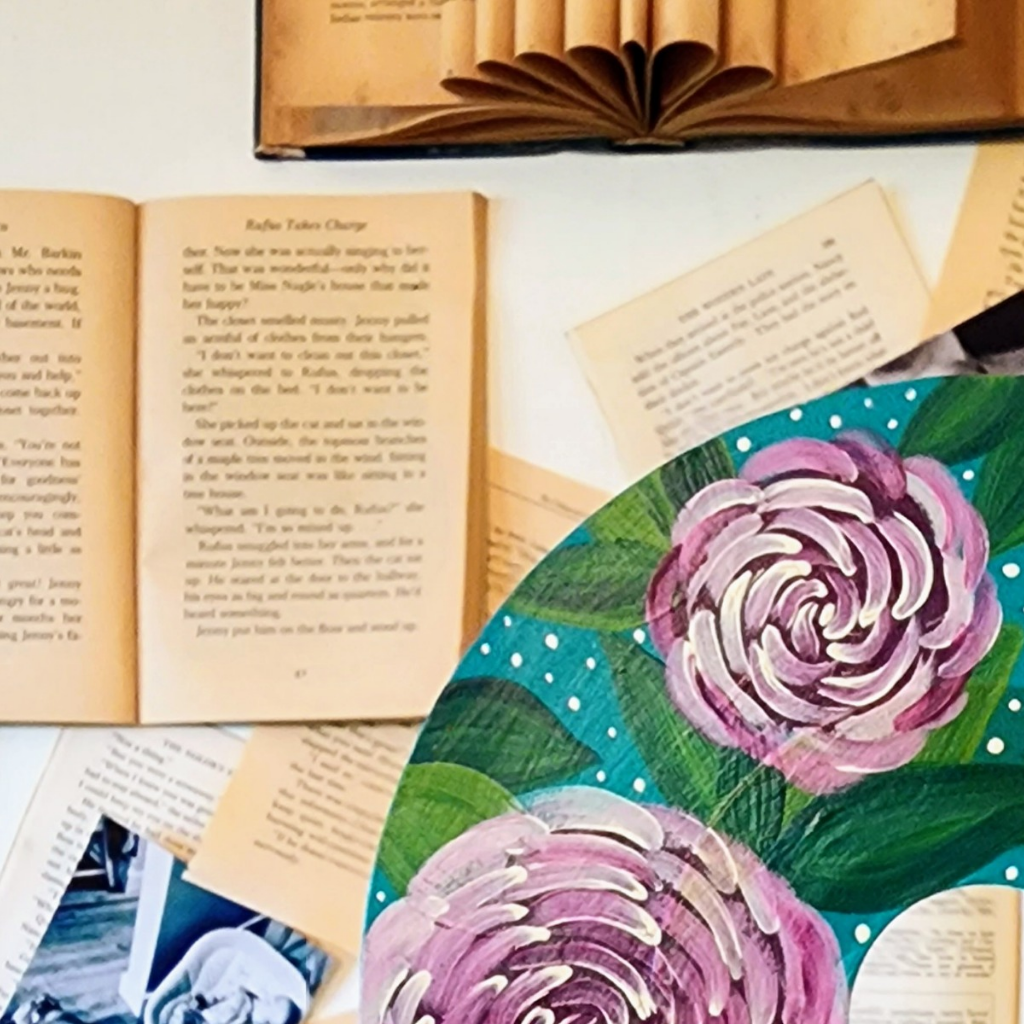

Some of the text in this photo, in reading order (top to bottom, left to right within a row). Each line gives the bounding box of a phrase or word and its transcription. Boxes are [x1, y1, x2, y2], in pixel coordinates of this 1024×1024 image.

[246, 218, 367, 232] Rufus Takes Charge
[213, 245, 241, 257] Now
[245, 244, 265, 256] she
[269, 247, 291, 256] was
[295, 244, 341, 258] actually
[345, 246, 389, 258] singing
[212, 263, 238, 275] That
[242, 265, 265, 275] was
[372, 262, 395, 276] why
[401, 262, 419, 274] did
[183, 280, 210, 292] have
[230, 280, 244, 292] be
[249, 280, 277, 292] Miss
[330, 279, 365, 291] house
[370, 279, 394, 291] that
[183, 297, 248, 311] her happy?
[198, 314, 219, 326] The
[260, 314, 307, 326] smelled
[355, 313, 390, 328] Jenny
[393, 313, 430, 328] pulled
[202, 332, 242, 344] armful
[247, 332, 259, 344] of
[264, 332, 307, 344] clothes
[311, 331, 341, 343] from
[346, 331, 373, 343] their
[211, 348, 382, 361] don't want clean out this
[183, 364, 429, 380] she whispered to Rufus, dropping the
